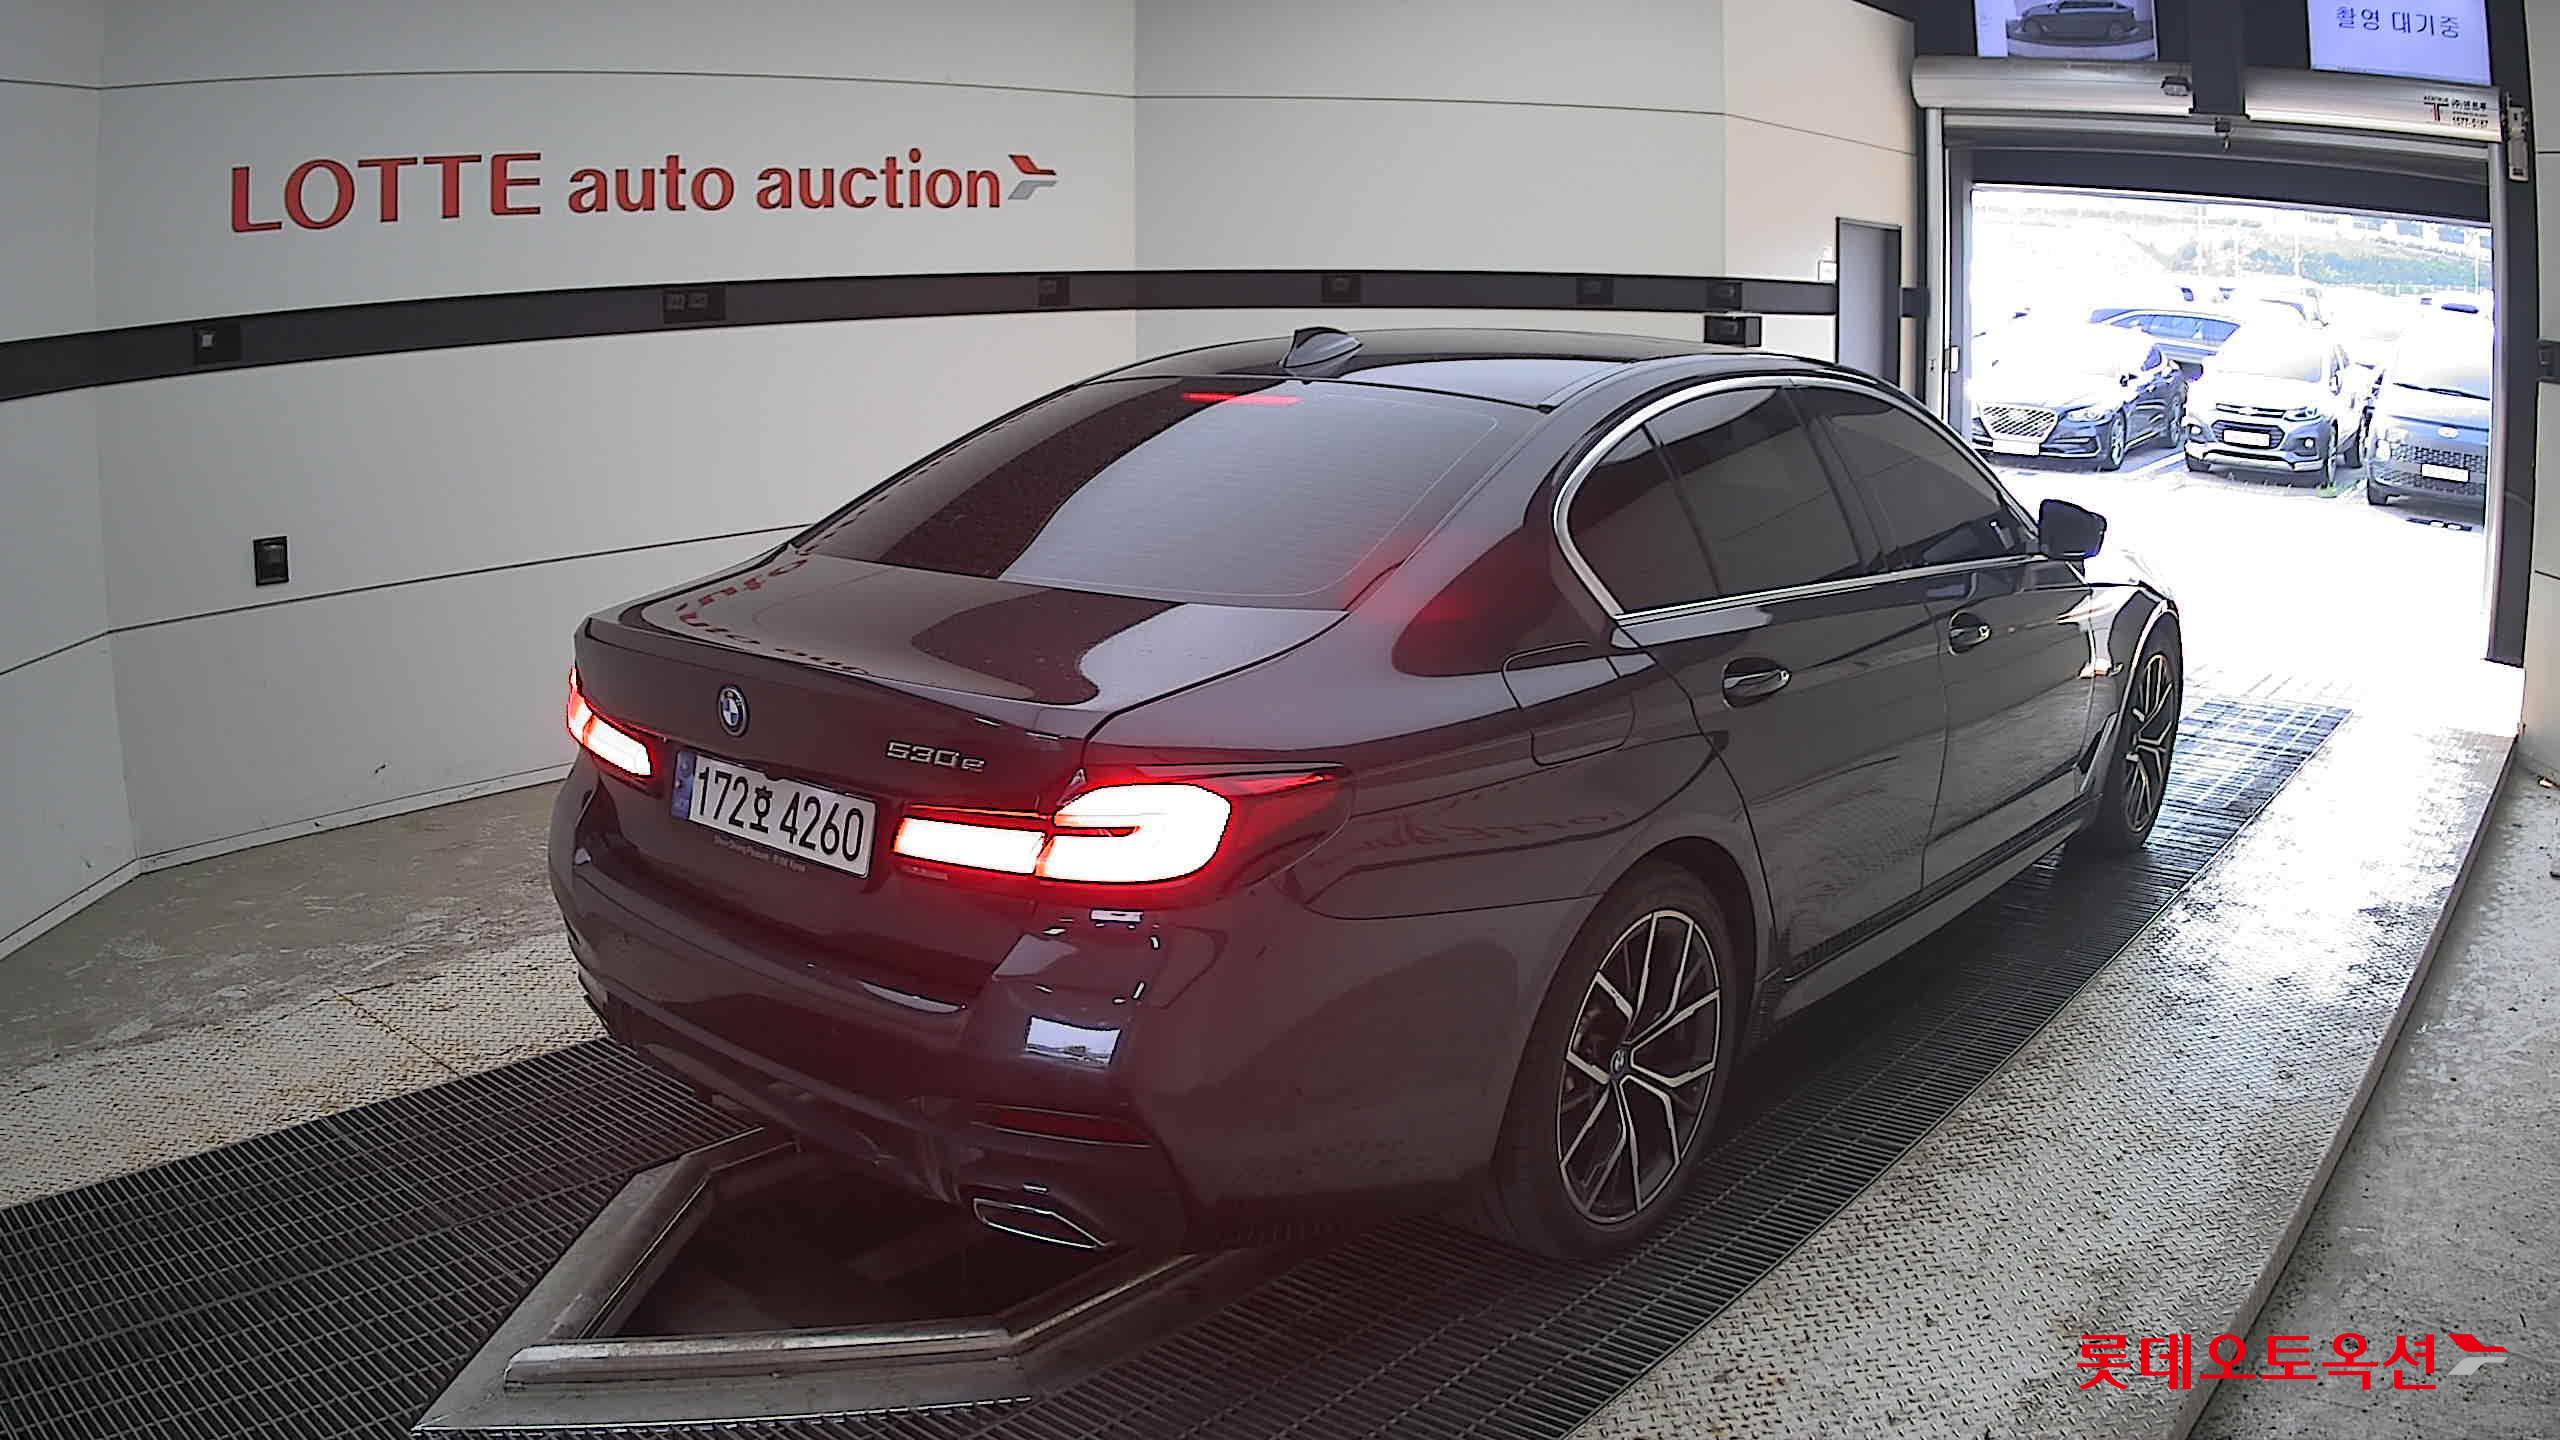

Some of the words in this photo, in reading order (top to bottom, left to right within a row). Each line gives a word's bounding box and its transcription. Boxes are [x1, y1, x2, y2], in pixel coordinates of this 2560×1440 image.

[2391, 11, 2459, 39] 대기중
[231, 152, 542, 234] LOTTE
[567, 154, 736, 213] auto
[755, 147, 1002, 210] auction
[886, 739, 986, 773] 530e
[698, 766, 773, 834] 172호
[779, 791, 865, 861] 4260
